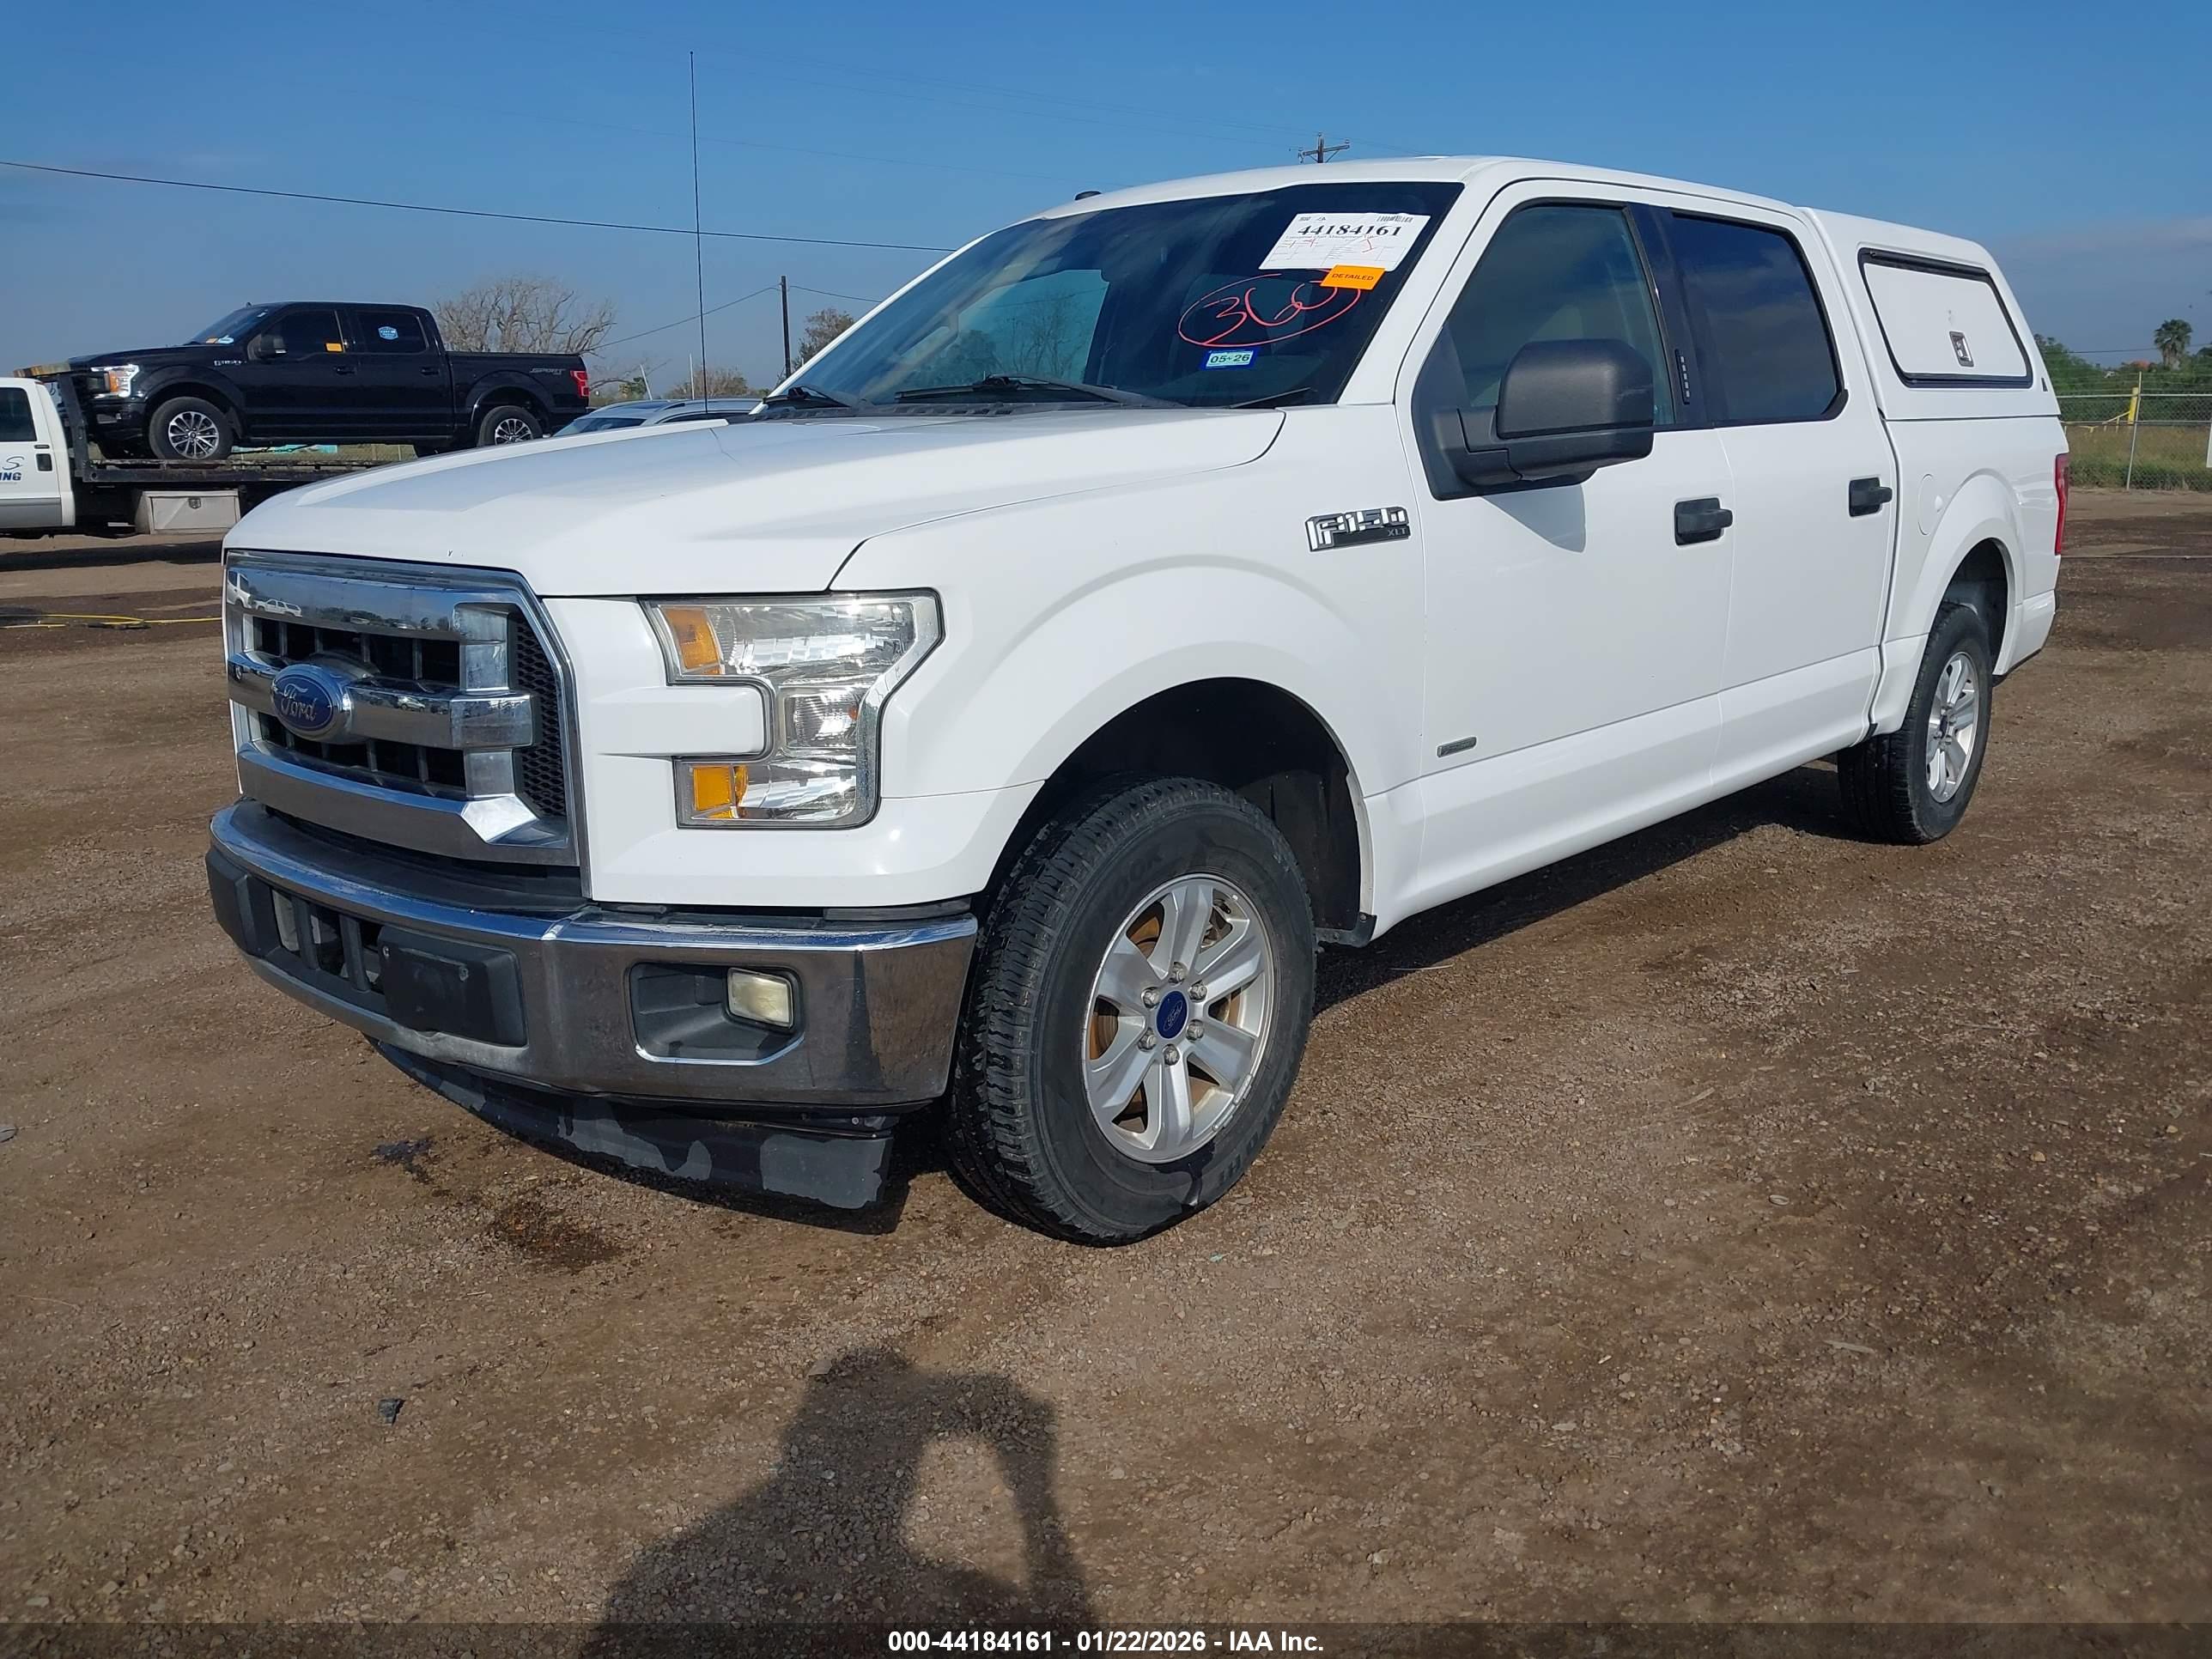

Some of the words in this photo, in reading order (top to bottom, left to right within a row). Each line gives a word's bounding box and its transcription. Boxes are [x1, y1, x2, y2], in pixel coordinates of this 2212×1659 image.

[1297, 224, 1402, 237] 44184161
[1387, 527, 1407, 537] XLT
[280, 684, 318, 721] Ford
